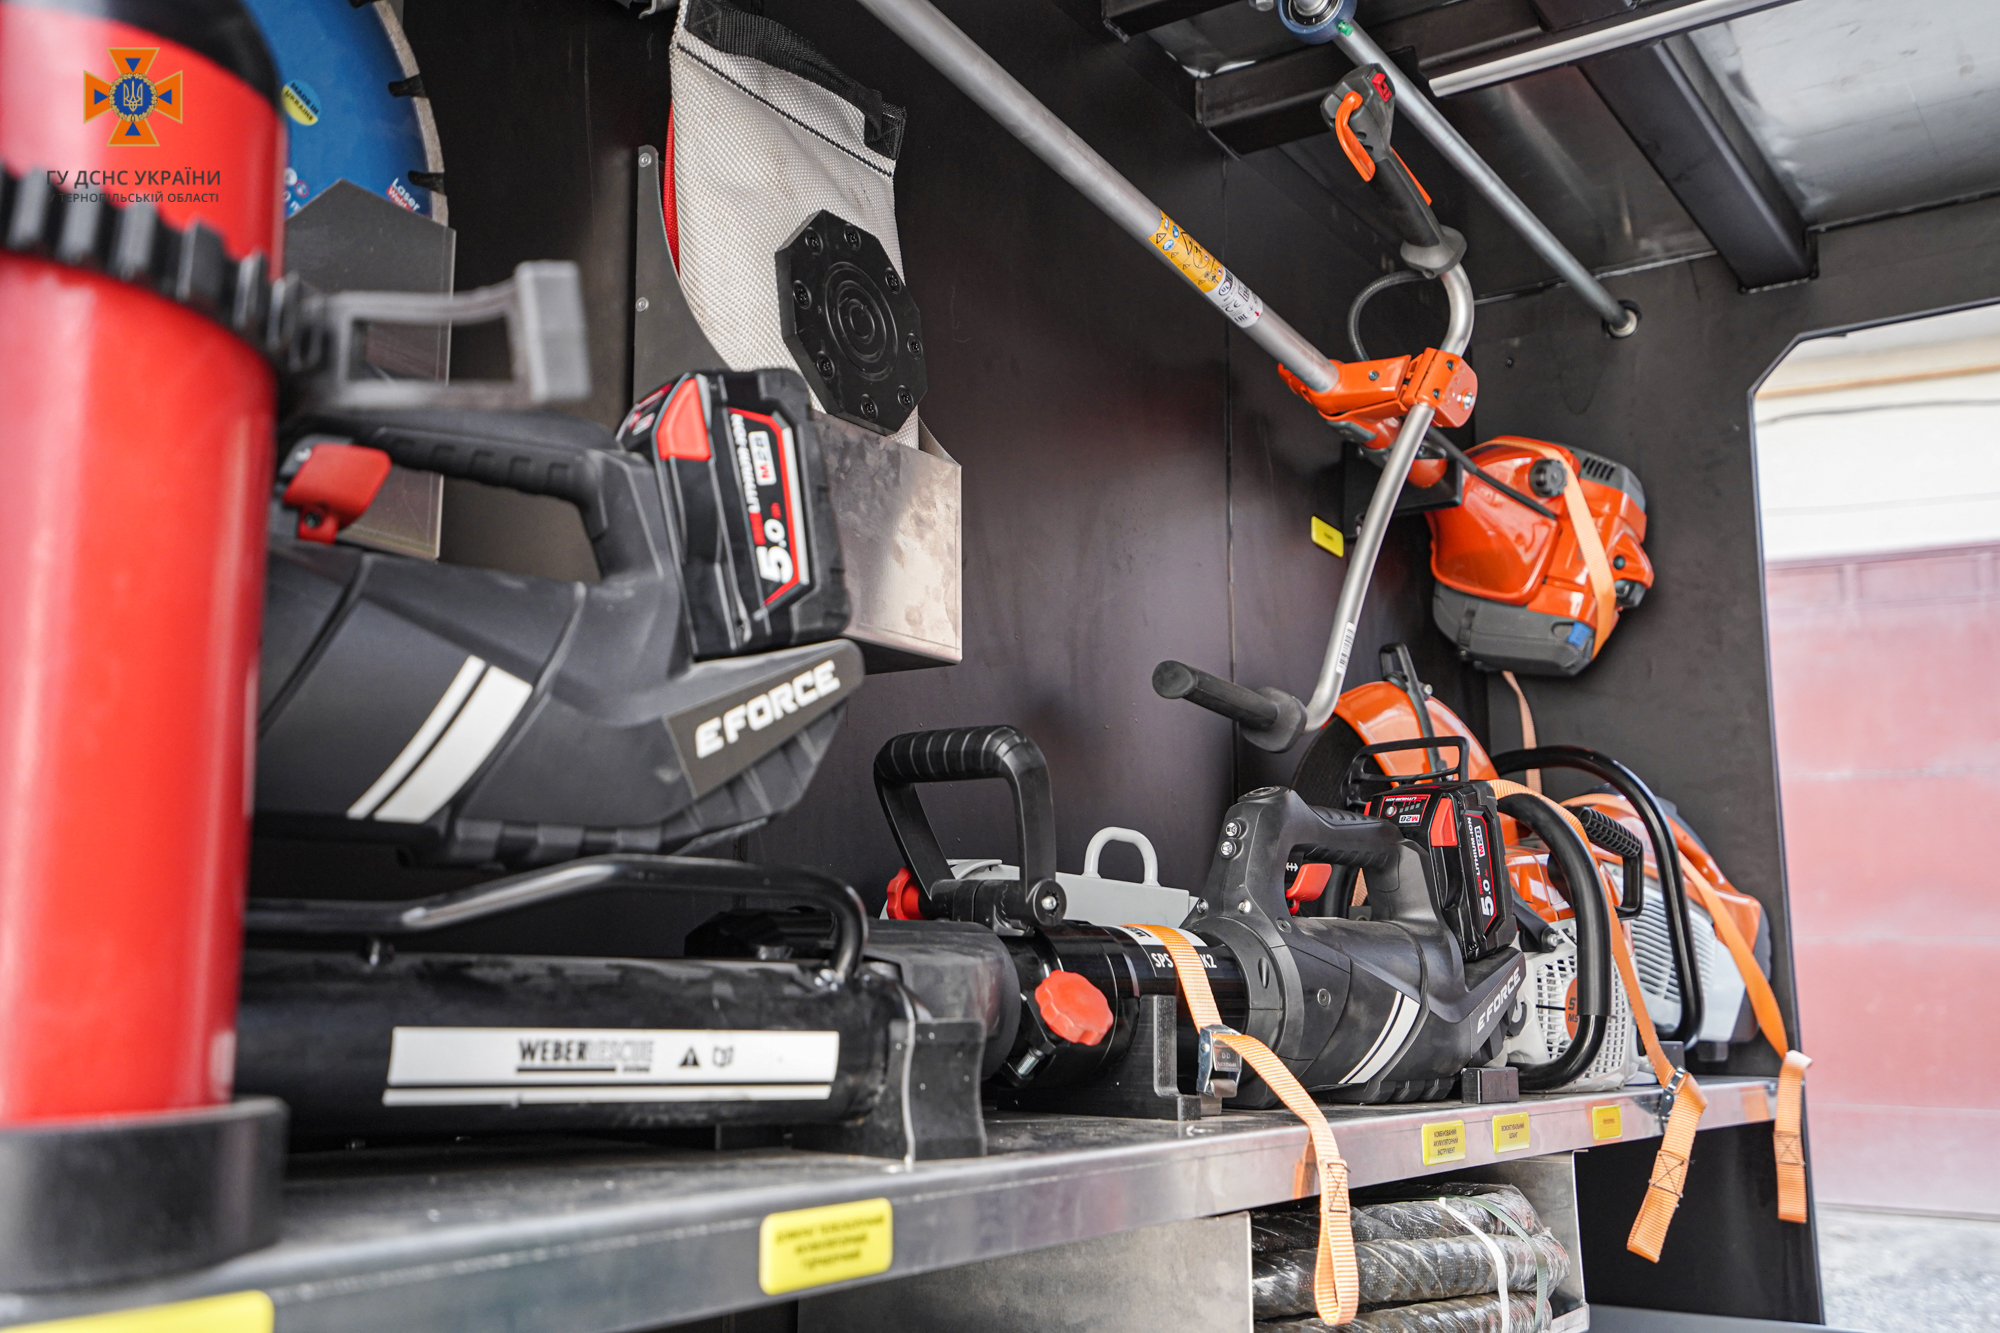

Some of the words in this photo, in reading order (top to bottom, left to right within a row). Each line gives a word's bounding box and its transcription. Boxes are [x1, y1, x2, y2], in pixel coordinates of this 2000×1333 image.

[284, 89, 315, 122] UKRAINE
[290, 81, 311, 106] MADE
[391, 176, 422, 212] Laser
[755, 518, 794, 584] 5.0
[1480, 878, 1496, 917] 5.0
[1150, 952, 1175, 968] SPS
